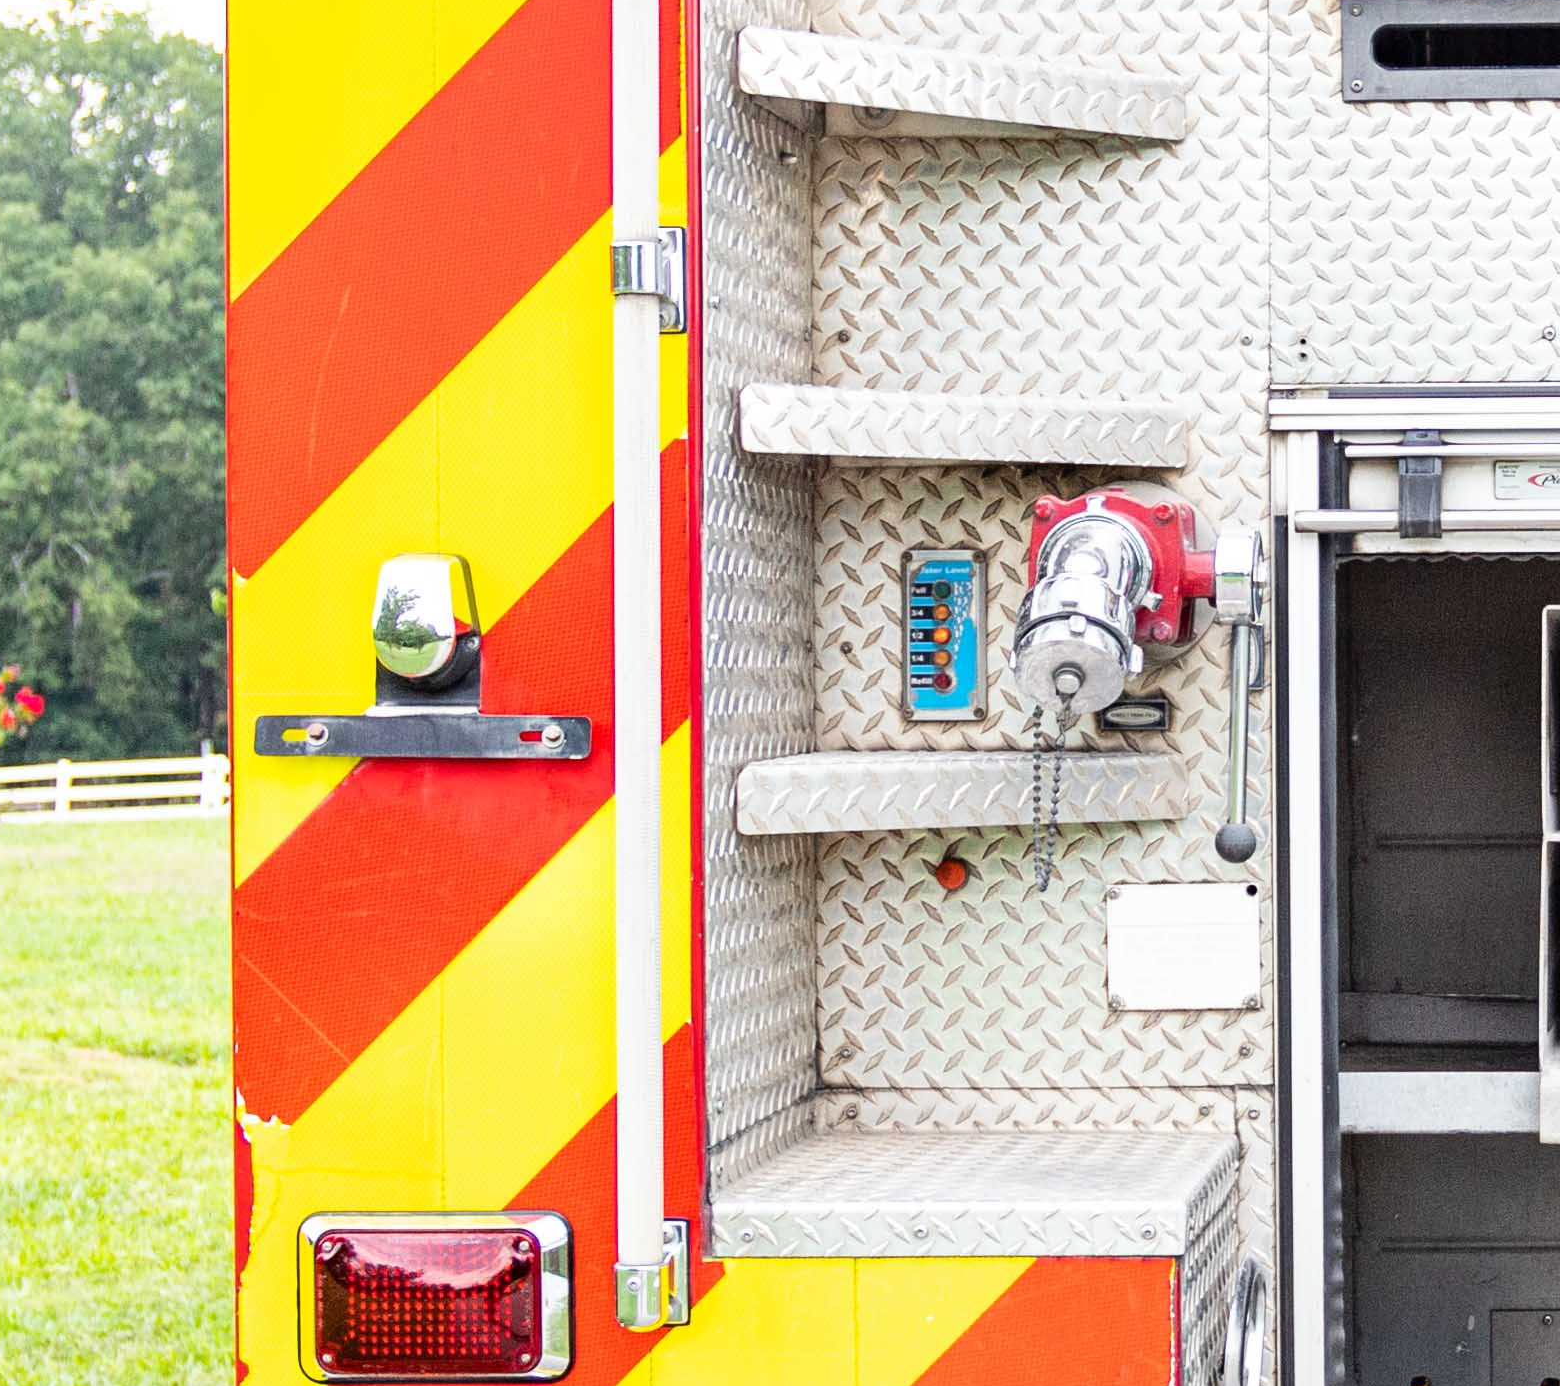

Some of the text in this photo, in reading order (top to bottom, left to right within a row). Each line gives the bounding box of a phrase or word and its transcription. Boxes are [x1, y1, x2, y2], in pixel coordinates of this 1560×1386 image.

[911, 609, 924, 617] 3/4
[911, 631, 924, 639] 1/2
[911, 654, 924, 662] 1/4
